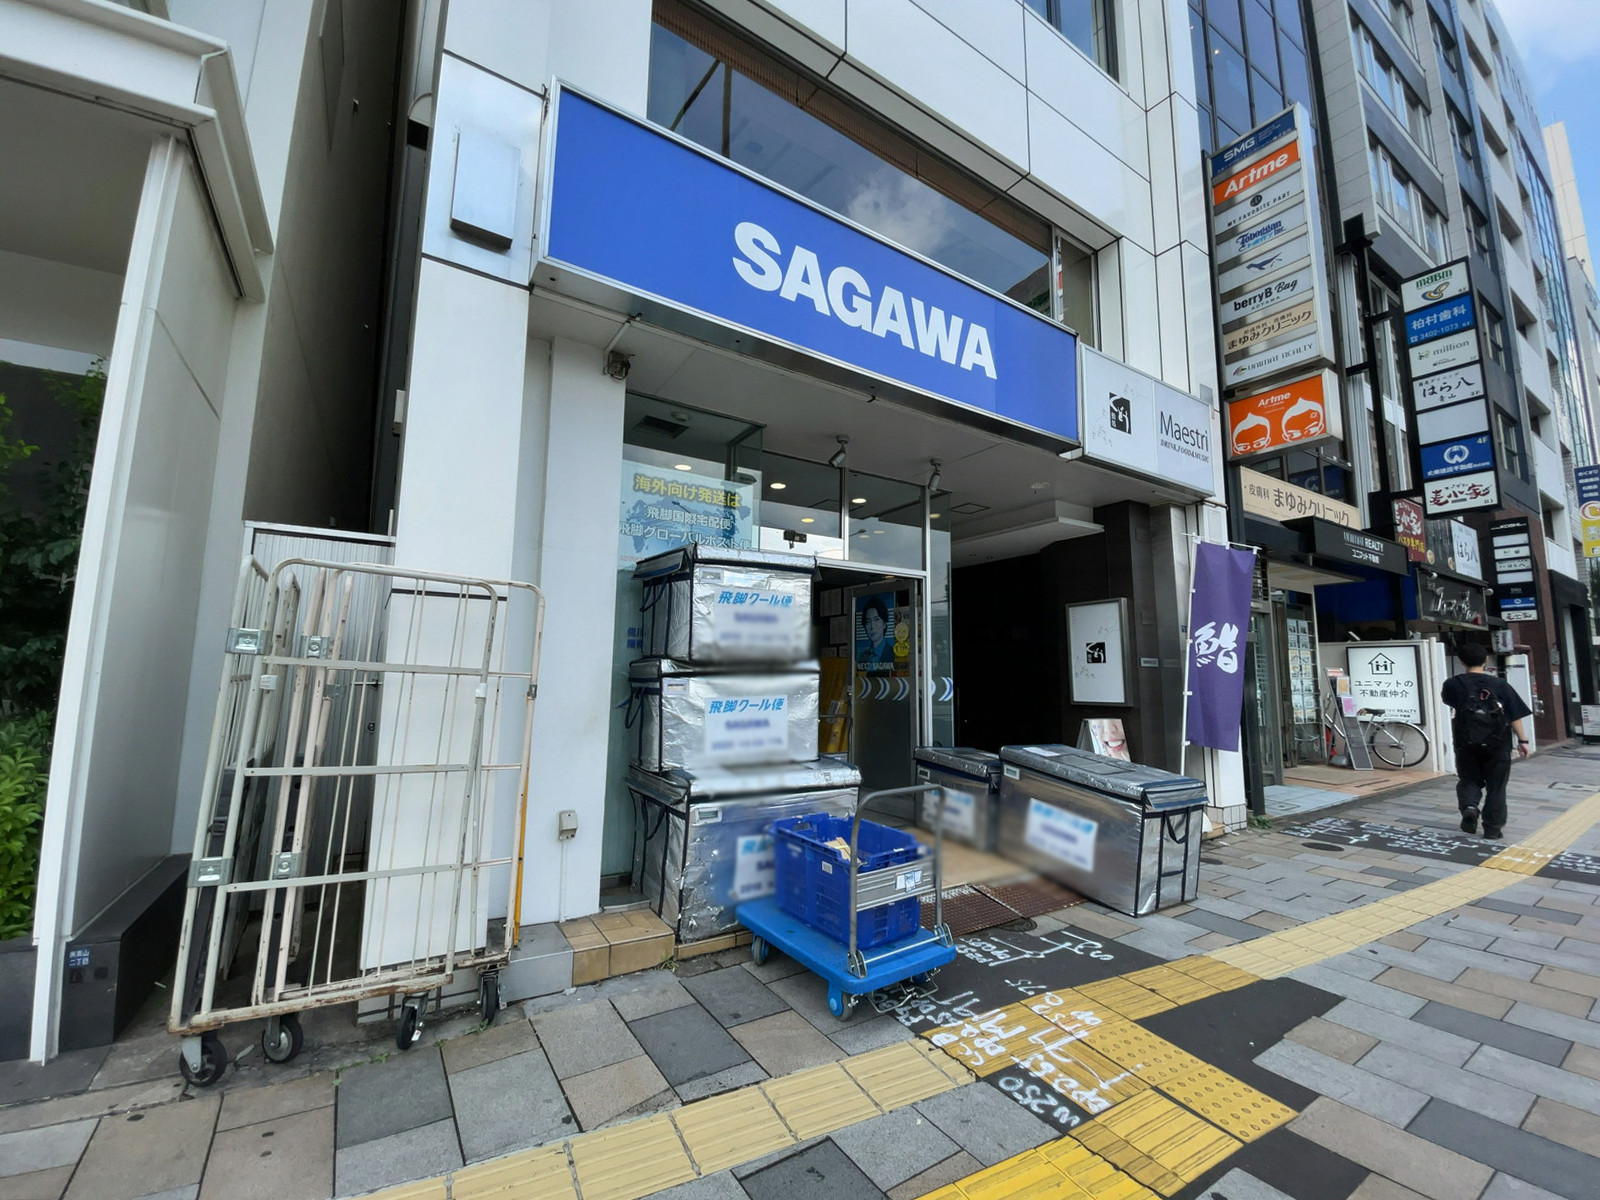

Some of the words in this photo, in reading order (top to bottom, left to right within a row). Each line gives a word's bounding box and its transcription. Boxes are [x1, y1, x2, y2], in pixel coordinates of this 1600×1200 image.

[1224, 137, 1255, 162] SMG
[1224, 152, 1289, 198] Artme
[732, 221, 998, 380] SAGAWA
[1234, 287, 1273, 312] berryB
[1275, 279, 1298, 294] Bag
[1411, 304, 1467, 331] 柏村歯科
[1227, 310, 1312, 350] まゆみクリニック
[1419, 323, 1459, 340] 3402-1073
[1432, 340, 1470, 356] million
[1257, 391, 1291, 408] Artme
[1422, 377, 1475, 398] はら八
[1160, 411, 1209, 452] Maestri
[633, 475, 742, 508] 海外向け発送は
[646, 506, 733, 530] 飛脚国際宅配便
[718, 590, 794, 607] 飛脚クール便
[1353, 679, 1414, 688] ユニマットの
[1359, 689, 1410, 699] 不動産仲介
[708, 697, 785, 714] 飛脚クール便
